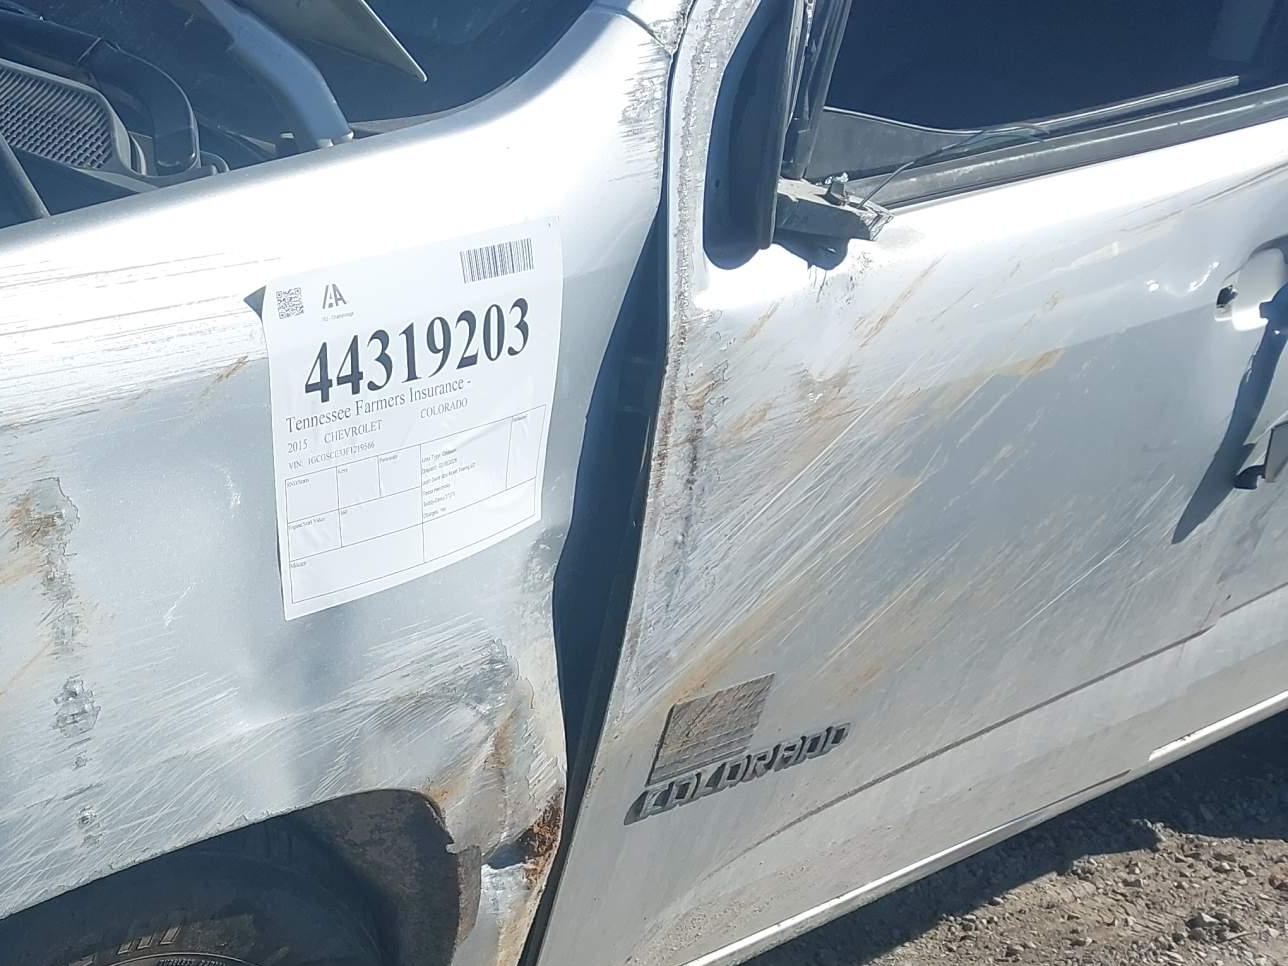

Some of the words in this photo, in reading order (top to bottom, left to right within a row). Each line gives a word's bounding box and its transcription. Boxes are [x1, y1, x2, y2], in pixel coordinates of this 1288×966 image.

[305, 297, 529, 403] 44319203
[286, 406, 351, 433] Tennessee
[355, 391, 405, 416] Farmers
[409, 378, 464, 402] Insurance
[287, 438, 309, 454] 2015
[323, 419, 382, 444] CHEVROLET
[420, 397, 468, 419] COLORADO
[624, 722, 852, 825] COLORADO
